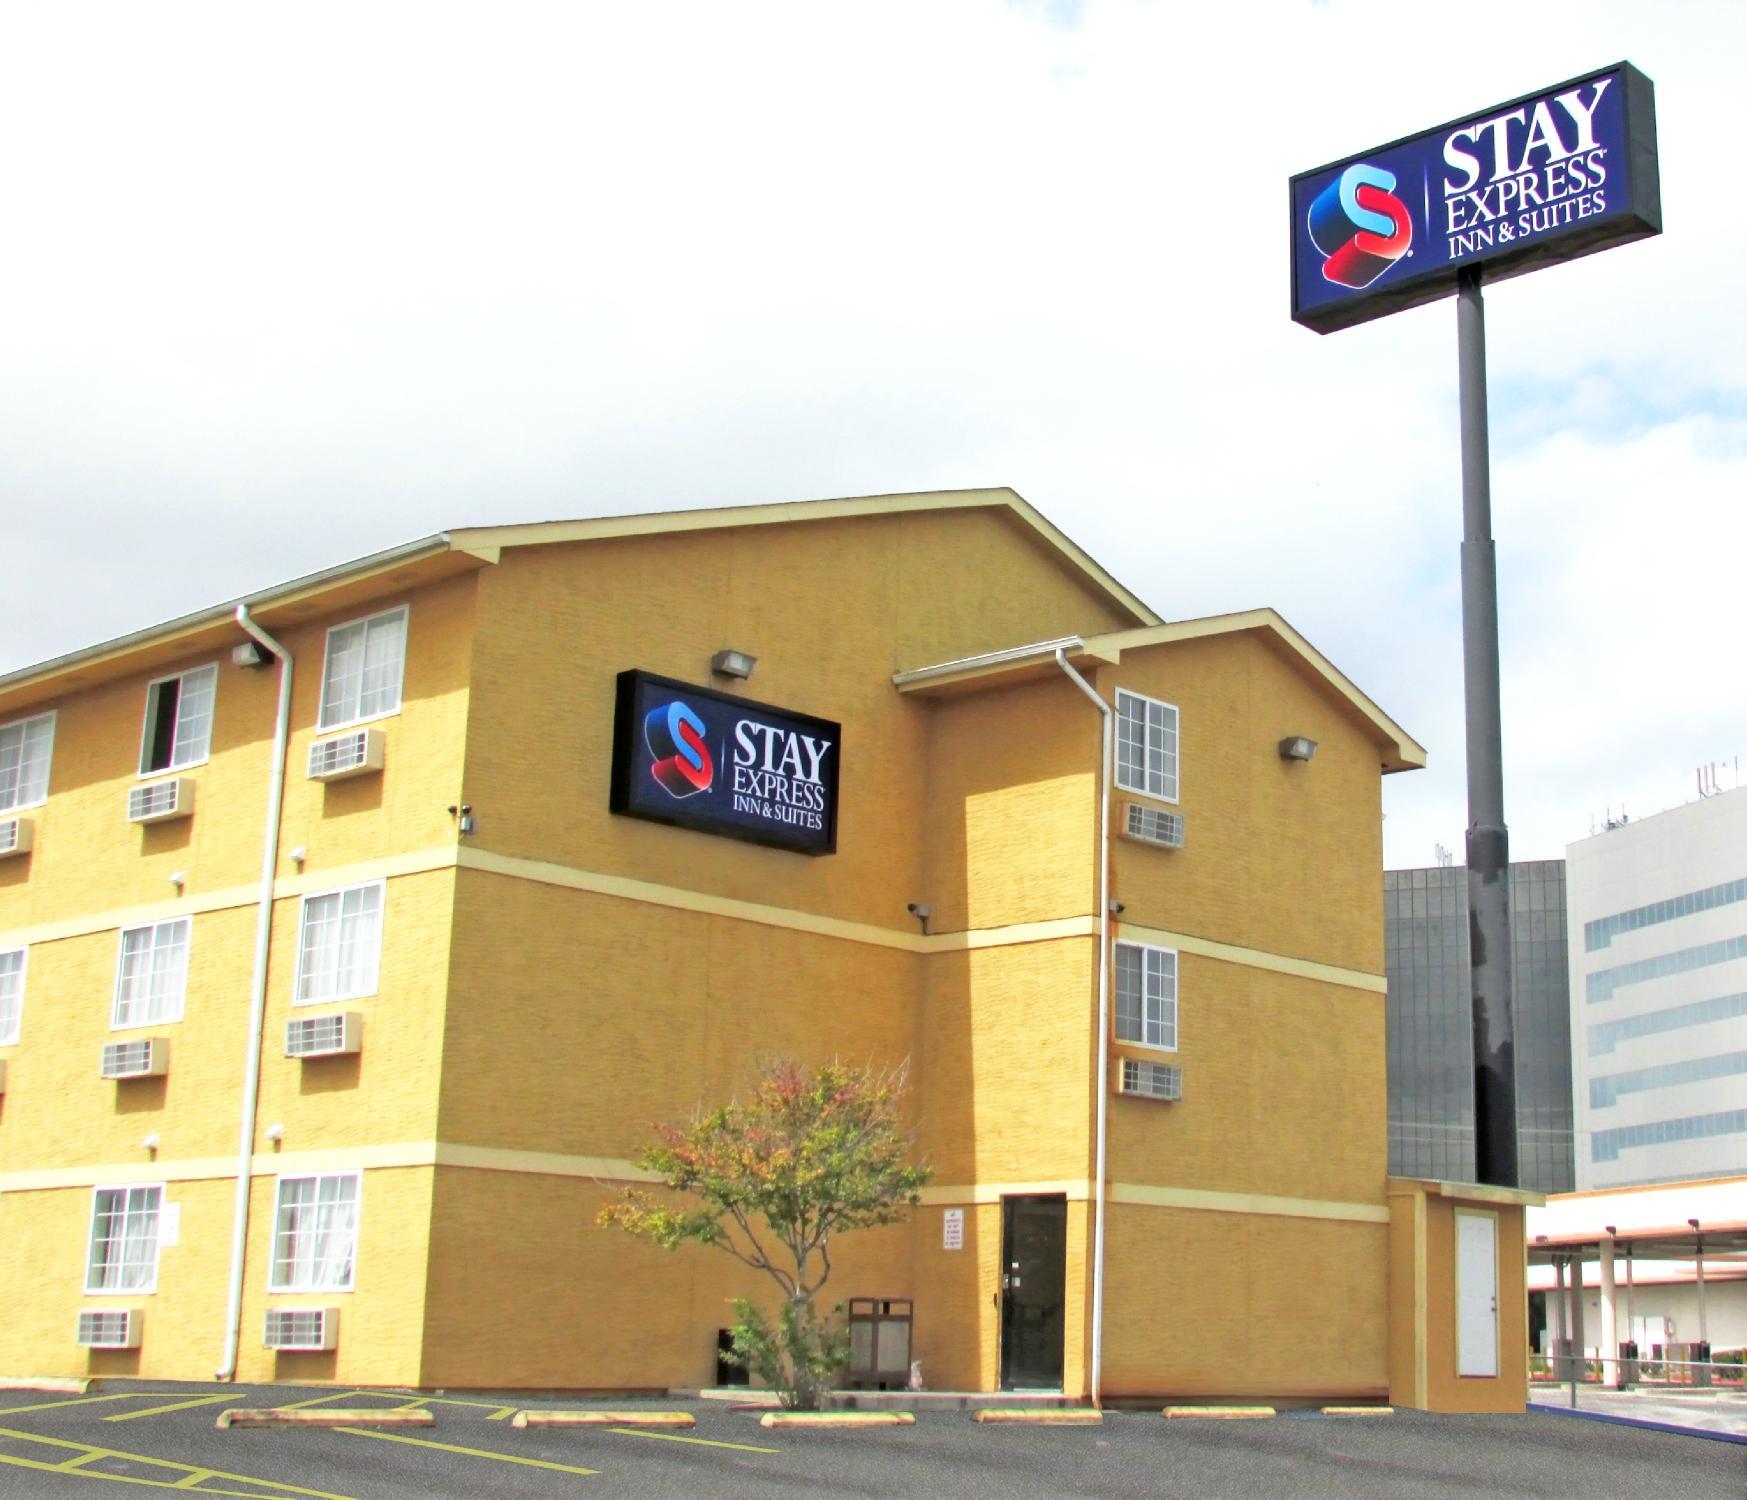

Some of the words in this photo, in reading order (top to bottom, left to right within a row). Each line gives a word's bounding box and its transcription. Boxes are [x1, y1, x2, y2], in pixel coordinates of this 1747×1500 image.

[1443, 79, 1611, 196] STAY
[1445, 151, 1606, 234] EXPRESS
[1448, 223, 1494, 259] INN
[1498, 220, 1516, 243] &
[1518, 190, 1606, 238] SUITES
[734, 719, 832, 785] STAY
[732, 766, 824, 811] EXPRESS
[733, 797, 761, 816] INN
[762, 802, 773, 819] &
[774, 804, 823, 831] SUITES
